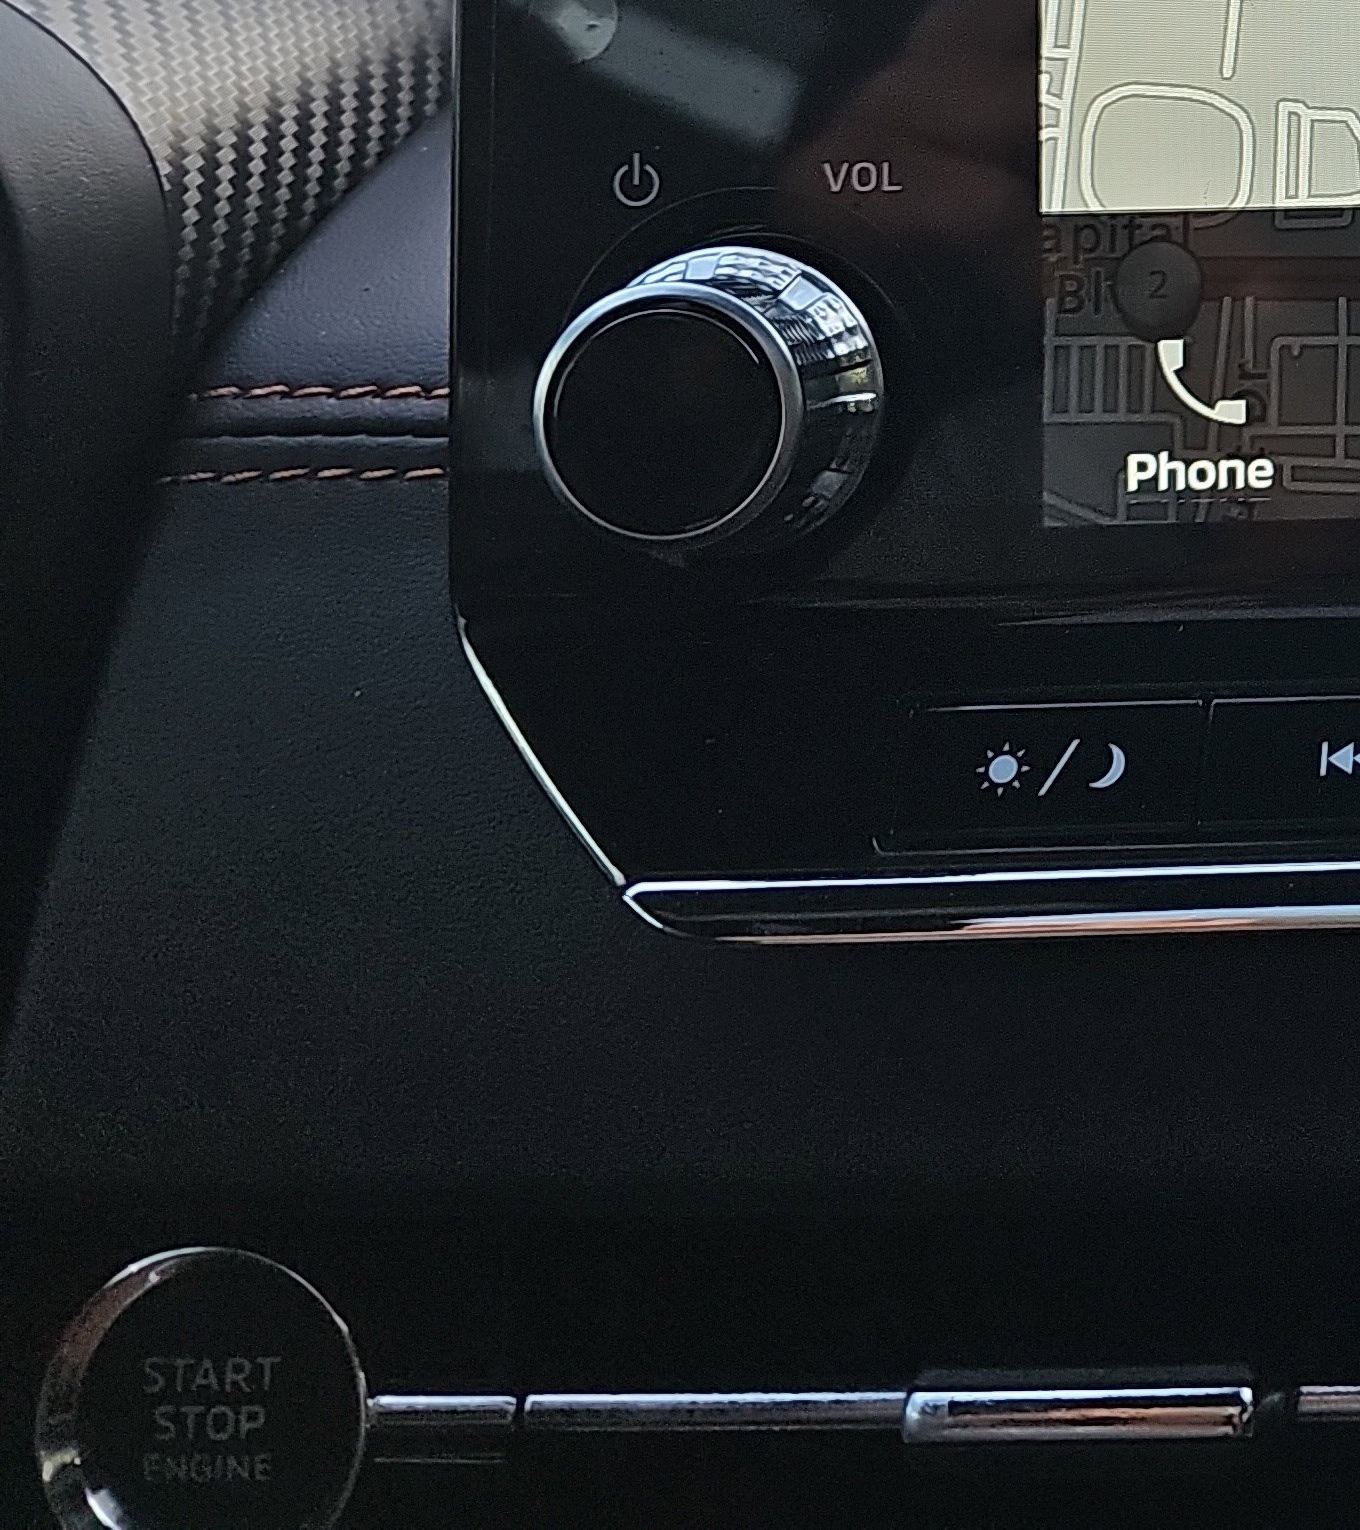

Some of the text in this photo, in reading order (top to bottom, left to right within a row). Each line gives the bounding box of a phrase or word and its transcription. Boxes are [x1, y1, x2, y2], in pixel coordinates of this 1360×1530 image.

[824, 161, 903, 193] VOL
[1149, 270, 1167, 299] 2
[1126, 451, 1275, 493] Phone
[142, 1355, 283, 1393] START
[153, 1405, 267, 1441] STOP
[143, 1452, 273, 1482] ENGINE
